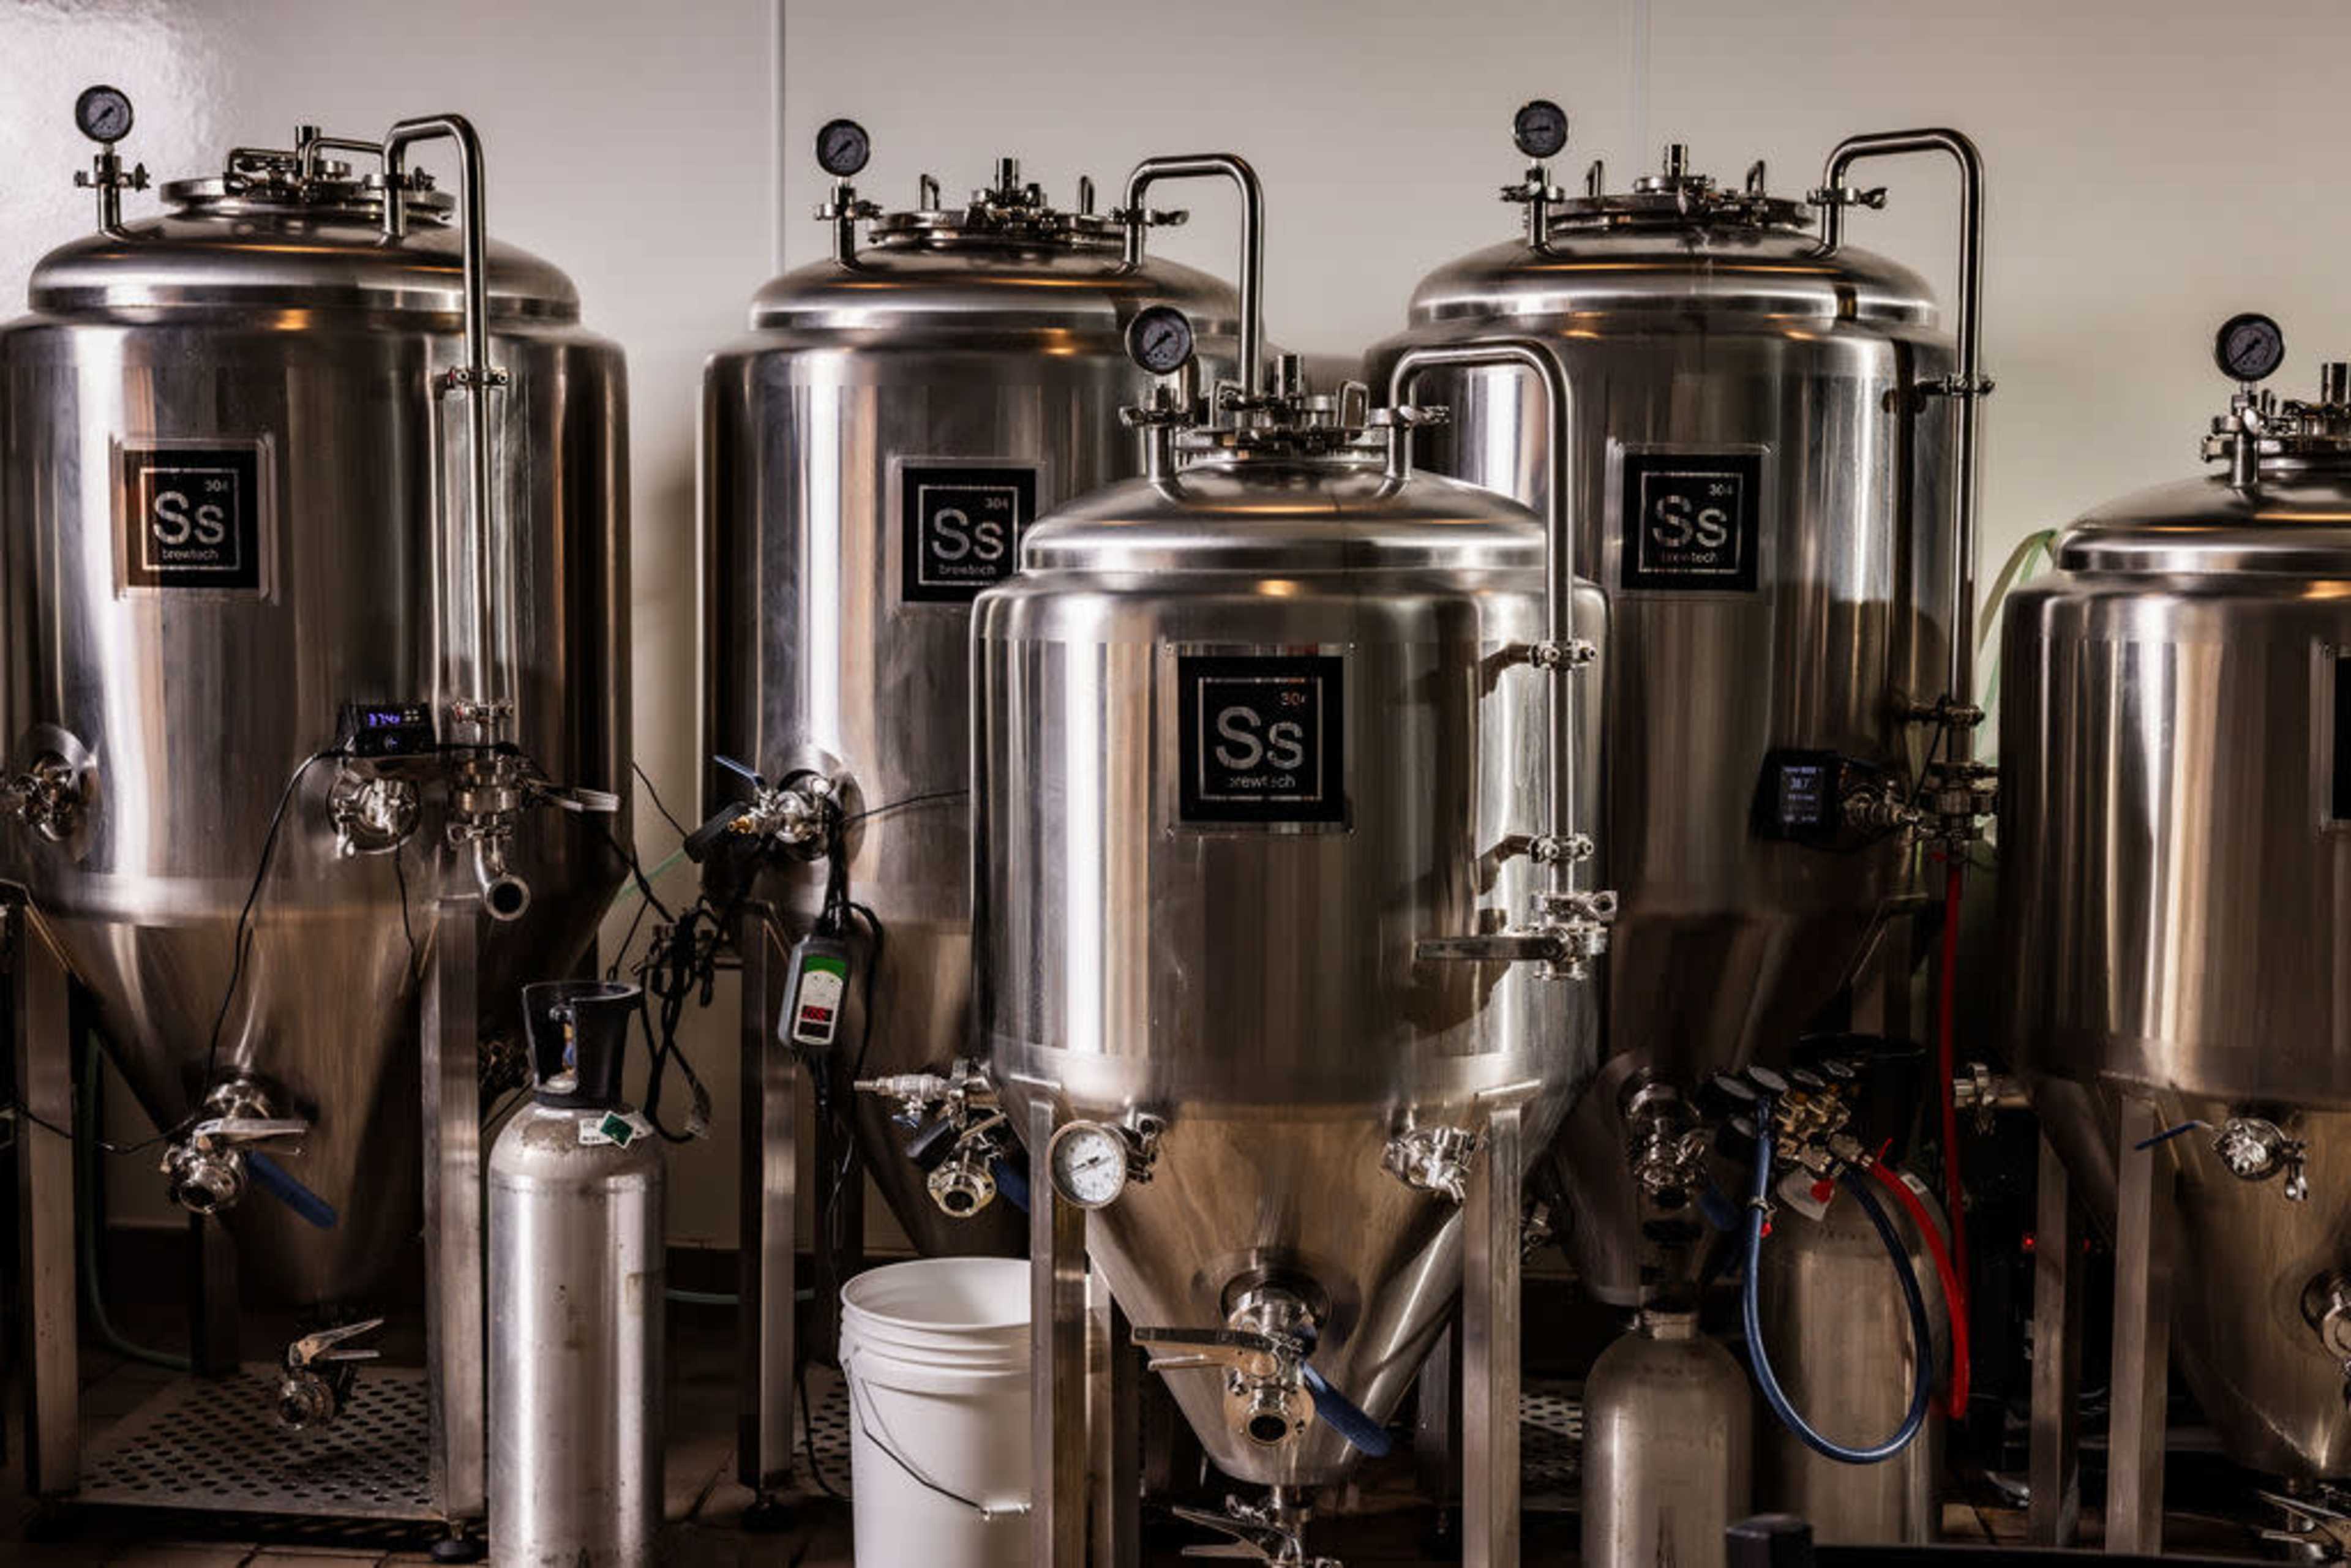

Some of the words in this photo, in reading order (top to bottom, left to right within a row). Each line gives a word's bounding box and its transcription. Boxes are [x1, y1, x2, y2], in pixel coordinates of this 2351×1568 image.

[153, 490, 225, 544] Ss
[931, 508, 1004, 560] Ss
[1652, 495, 1728, 547] Ss
[1215, 706, 1303, 770] Ss
